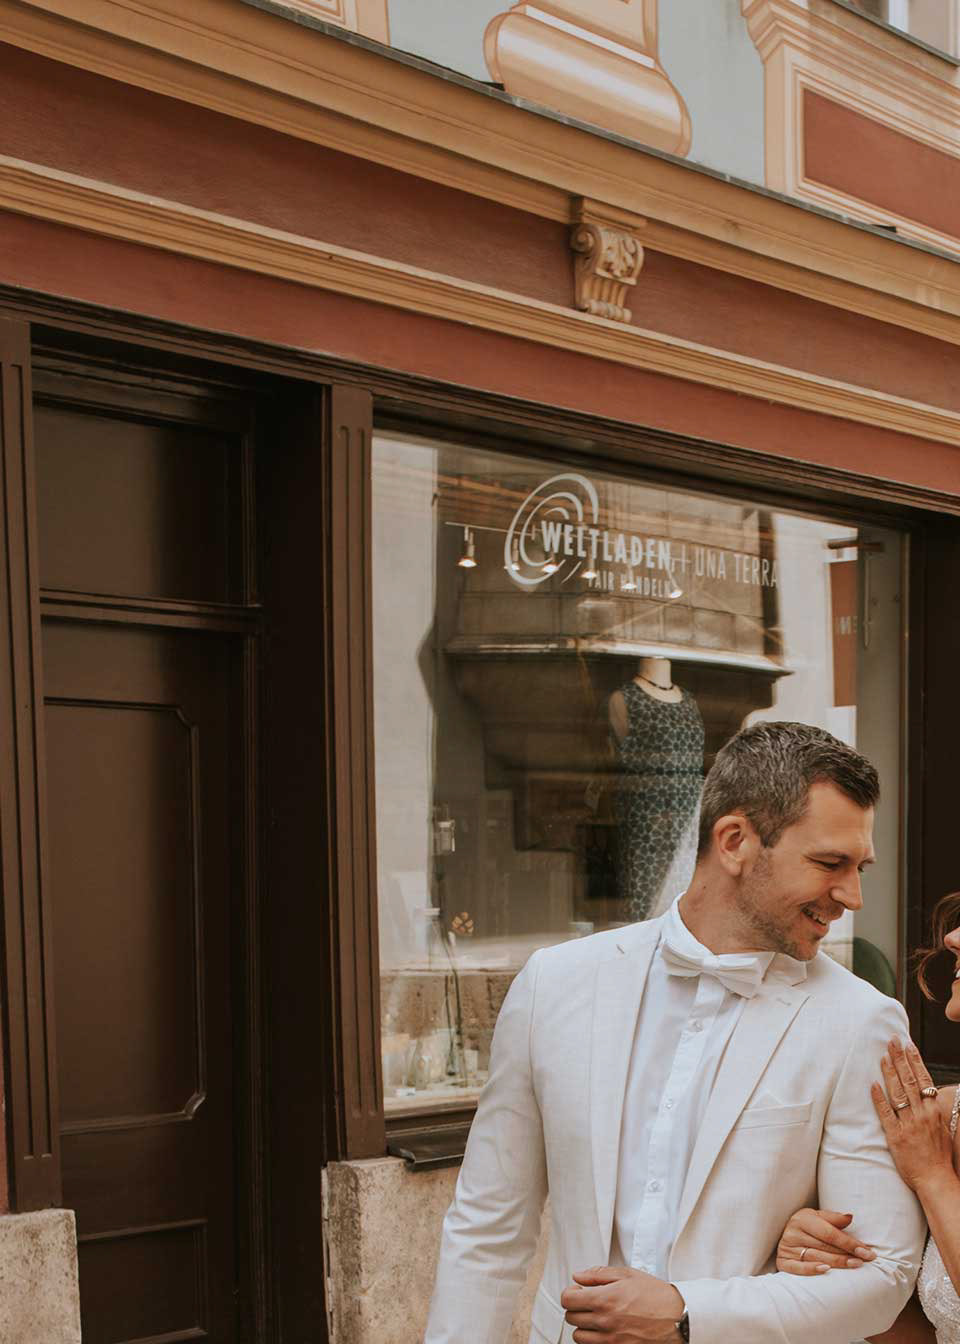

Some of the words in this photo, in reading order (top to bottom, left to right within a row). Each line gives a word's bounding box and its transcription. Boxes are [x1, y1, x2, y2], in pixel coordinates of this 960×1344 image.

[540, 519, 673, 570] WELTLADEN
[694, 546, 727, 580] UNA
[733, 553, 778, 587] TERRA
